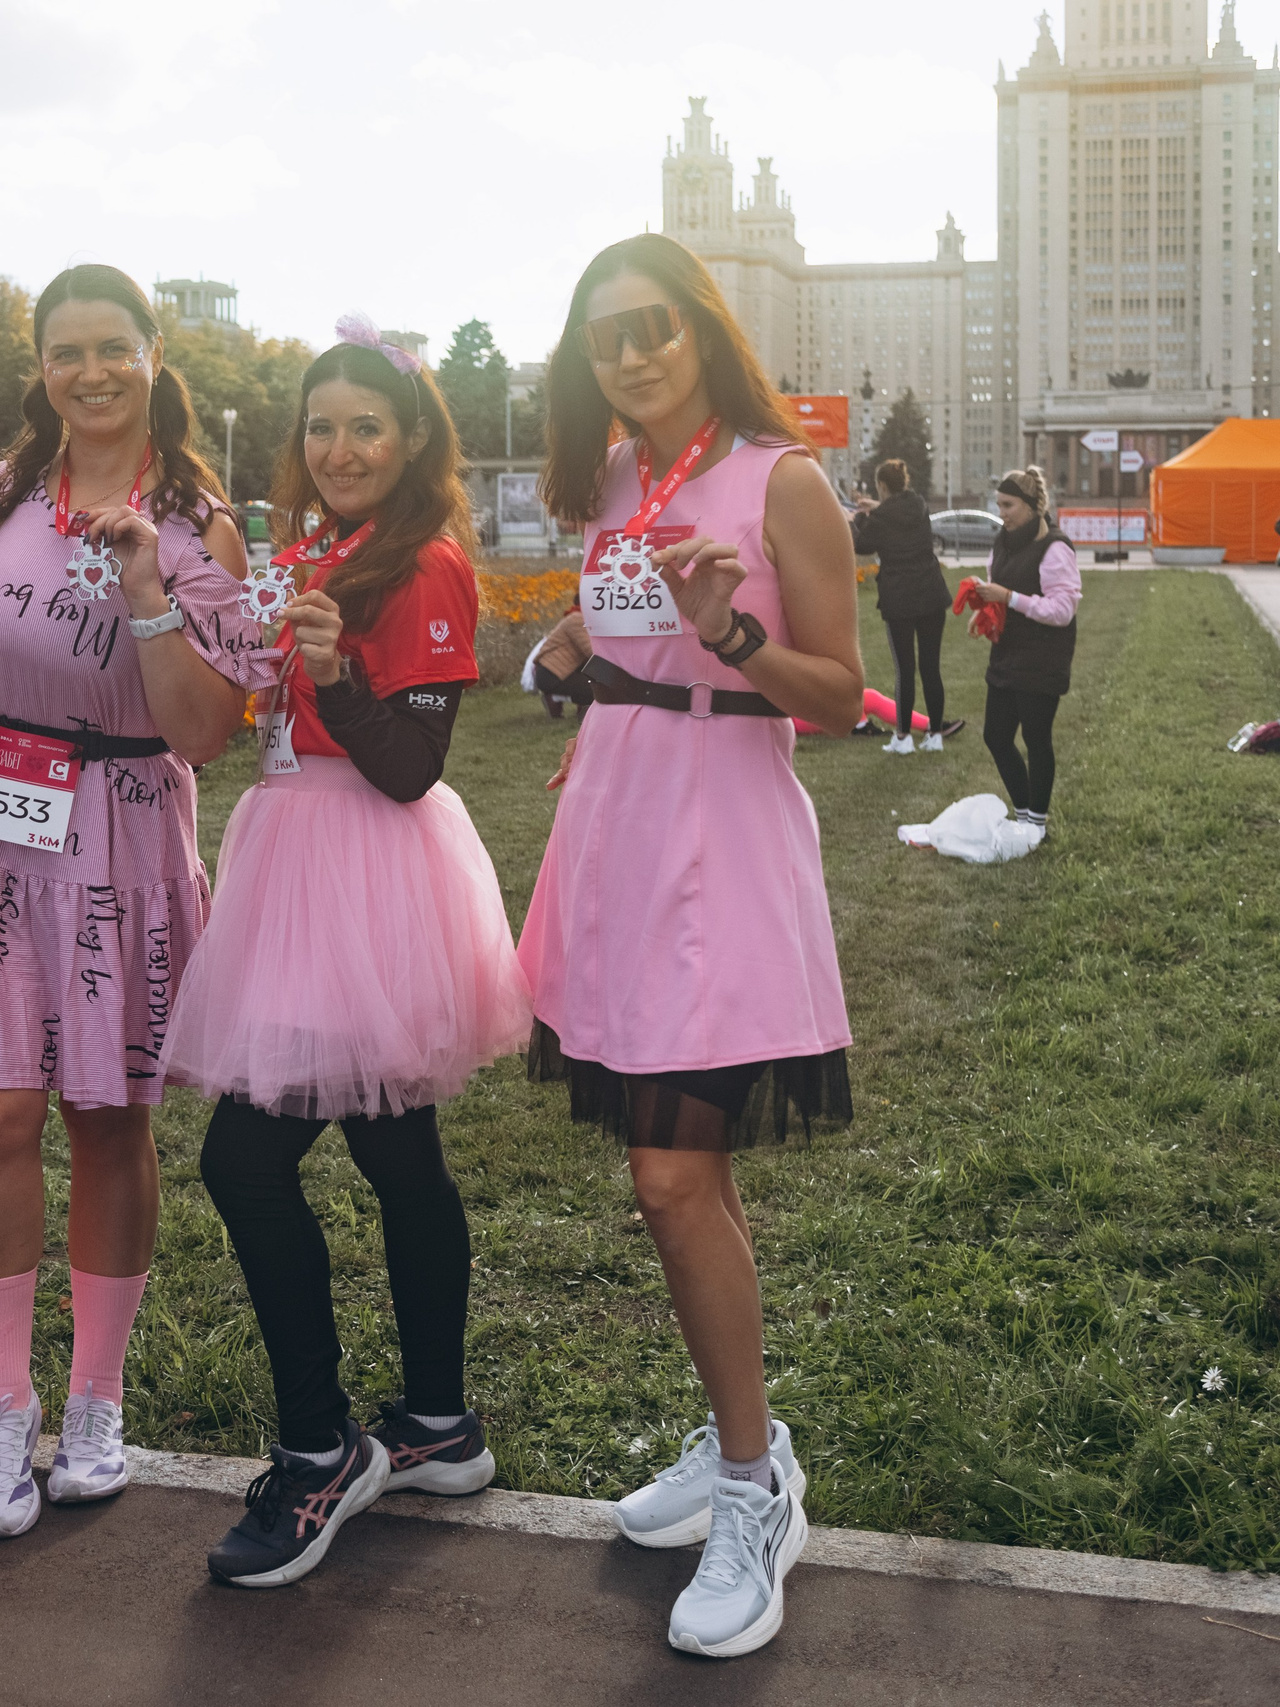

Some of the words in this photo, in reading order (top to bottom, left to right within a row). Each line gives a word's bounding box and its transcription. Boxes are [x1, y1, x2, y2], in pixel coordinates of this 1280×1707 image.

[591, 585, 662, 611] 31526
[649, 621, 655, 632] 3
[408, 692, 448, 707] HRX
[27, 833, 35, 844] 3
[39, 835, 60, 848] КМ
